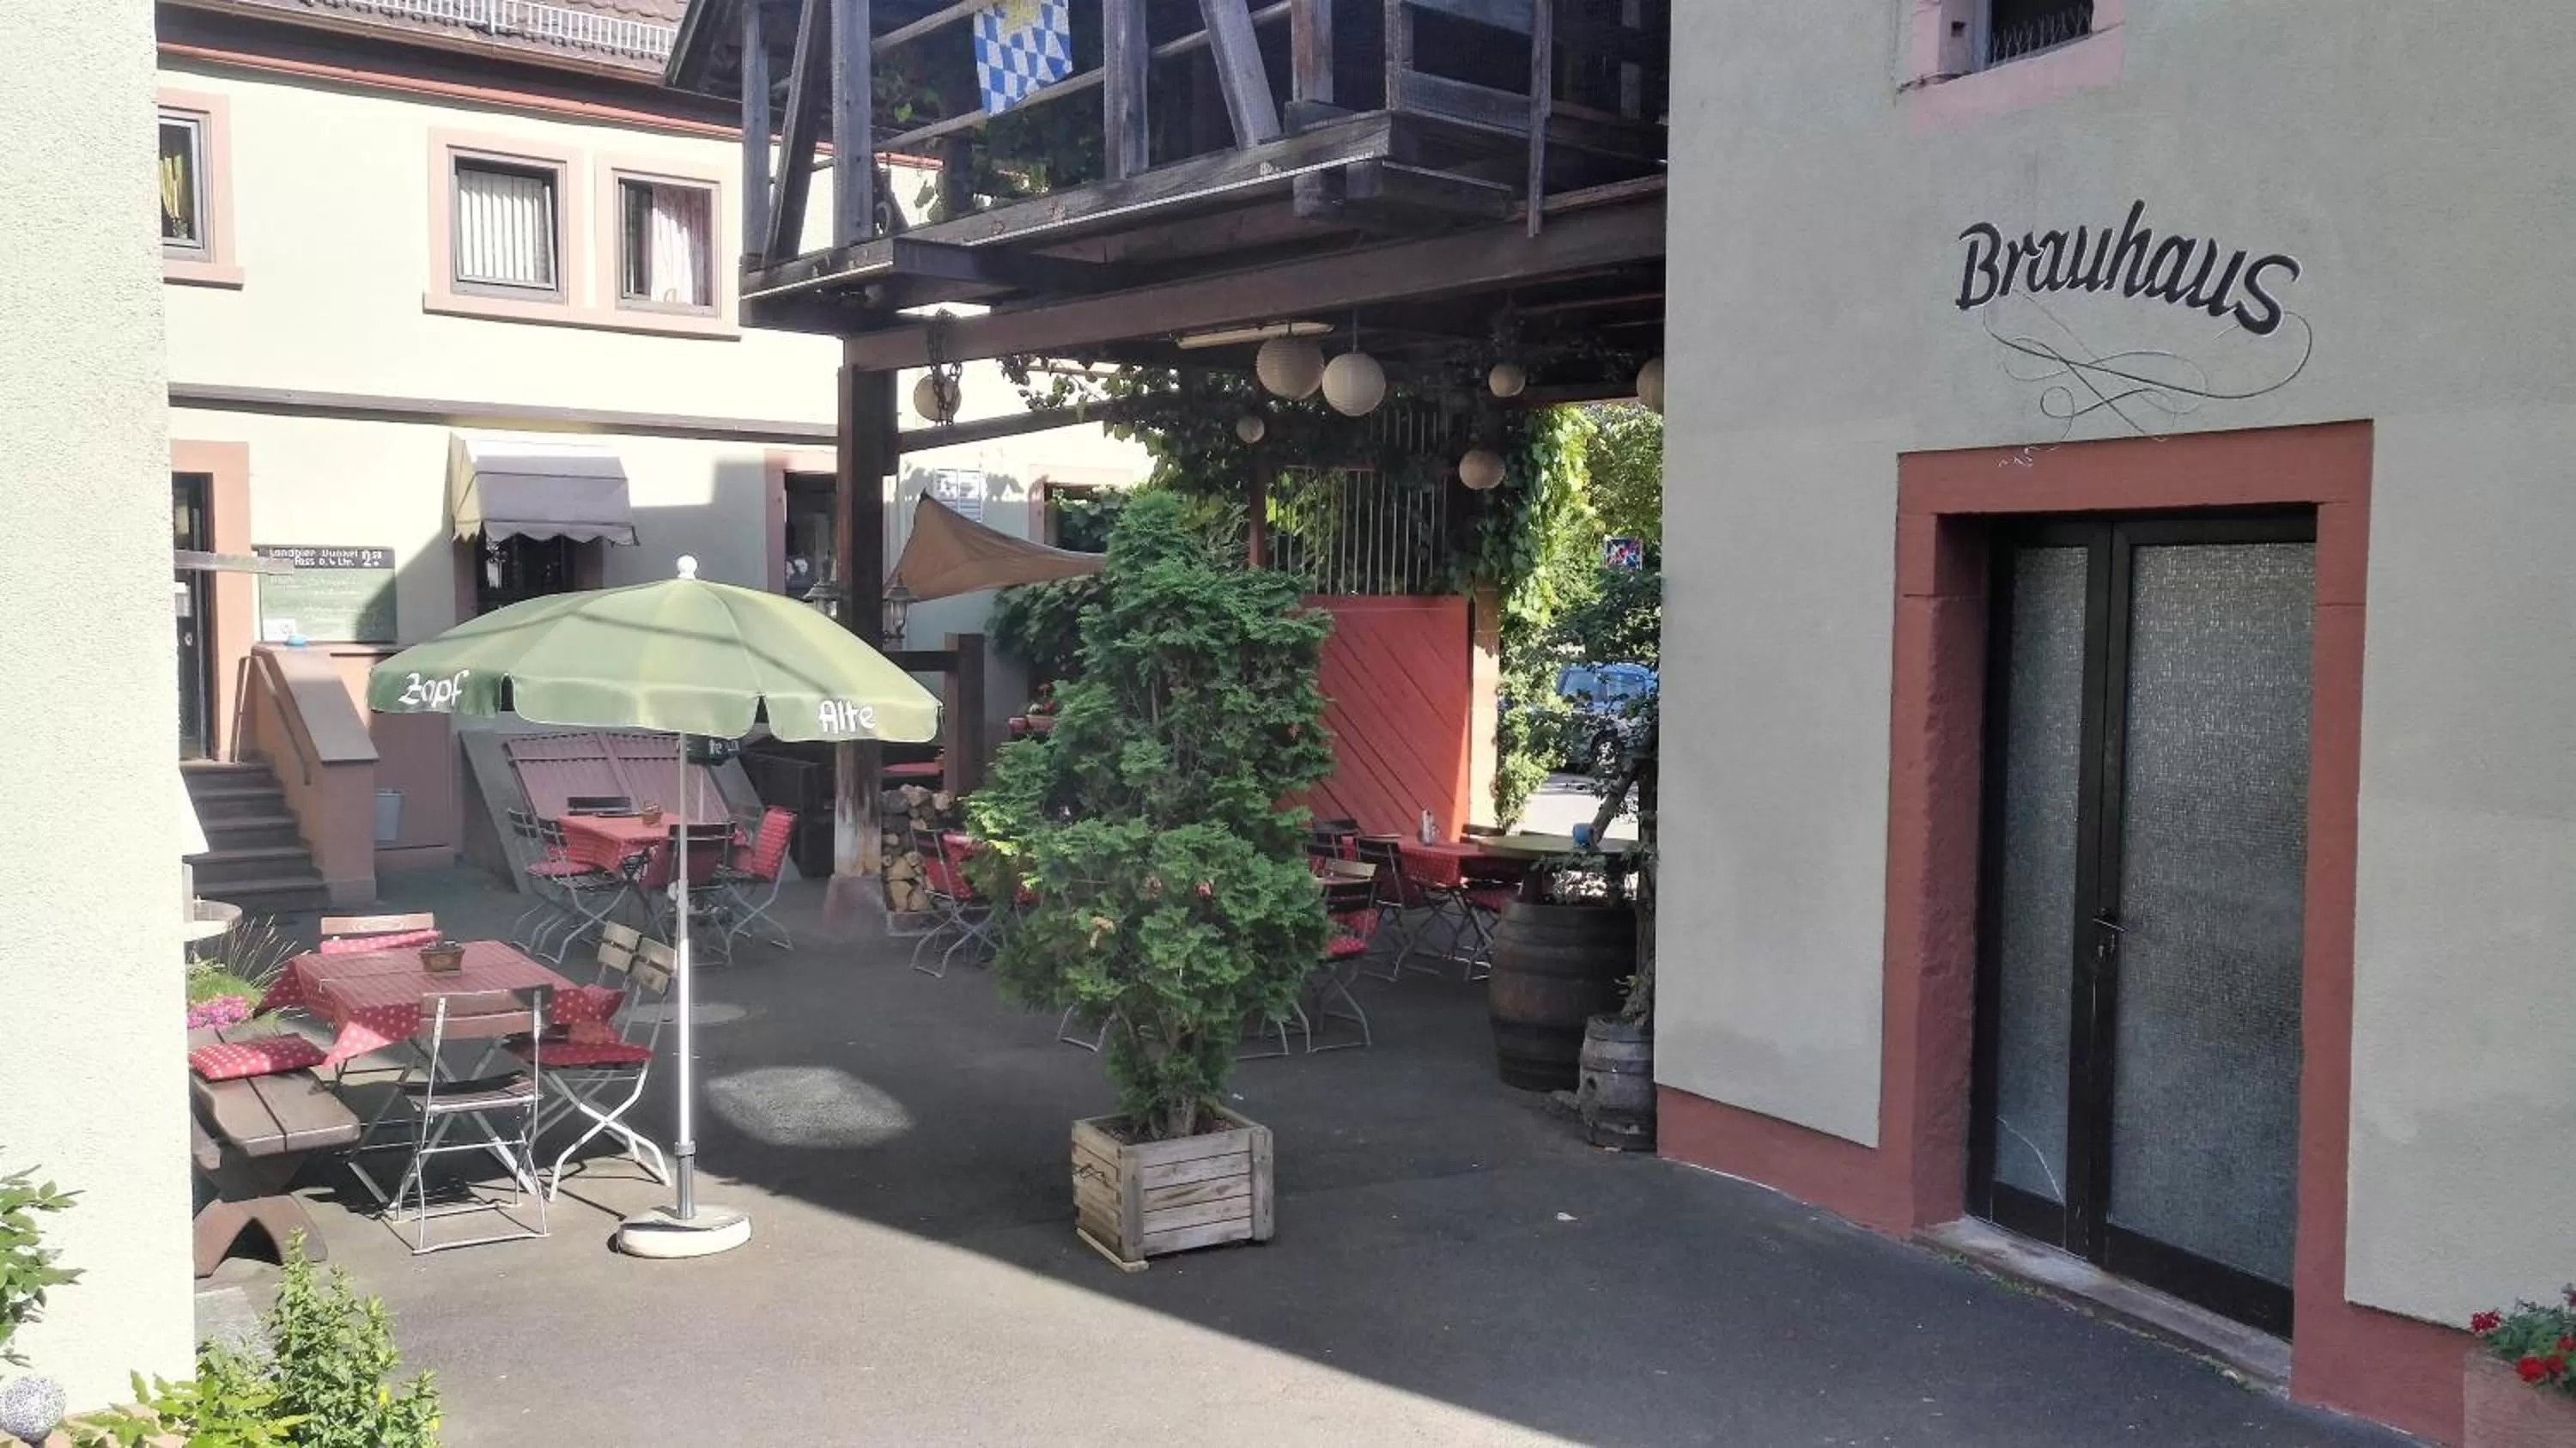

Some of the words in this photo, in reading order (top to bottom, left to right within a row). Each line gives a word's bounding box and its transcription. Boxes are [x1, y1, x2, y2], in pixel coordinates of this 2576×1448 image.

[1954, 199, 2303, 338] Brauhaus
[398, 669, 470, 709] Zopf
[818, 700, 877, 734] Alte
